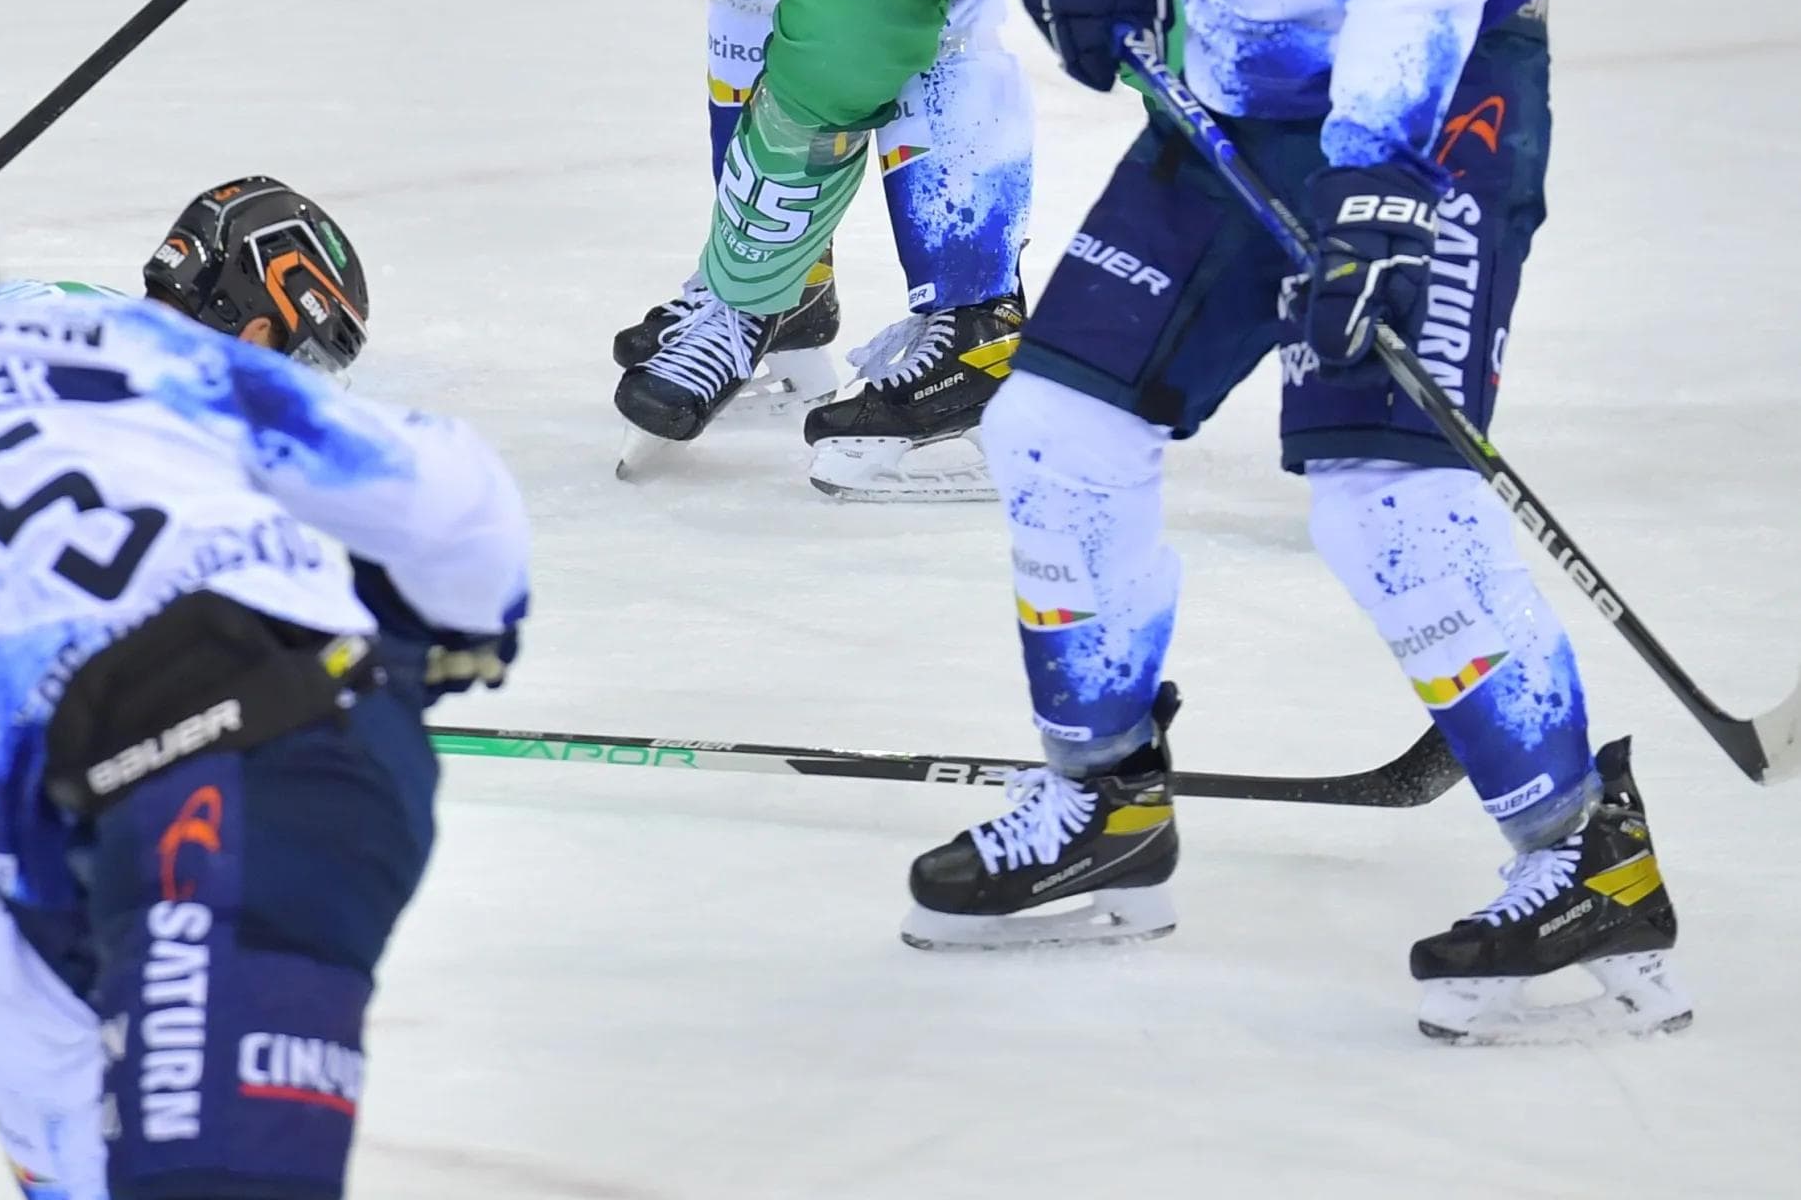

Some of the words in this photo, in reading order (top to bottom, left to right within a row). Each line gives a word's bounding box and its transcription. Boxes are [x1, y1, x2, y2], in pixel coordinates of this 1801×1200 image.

[718, 134, 821, 244] 25
[1067, 232, 1172, 297] AUER
[913, 372, 965, 401] BAUER
[88, 698, 242, 797] BAUER
[1538, 898, 1594, 939] BAUER
[138, 898, 213, 1143] SATURN
